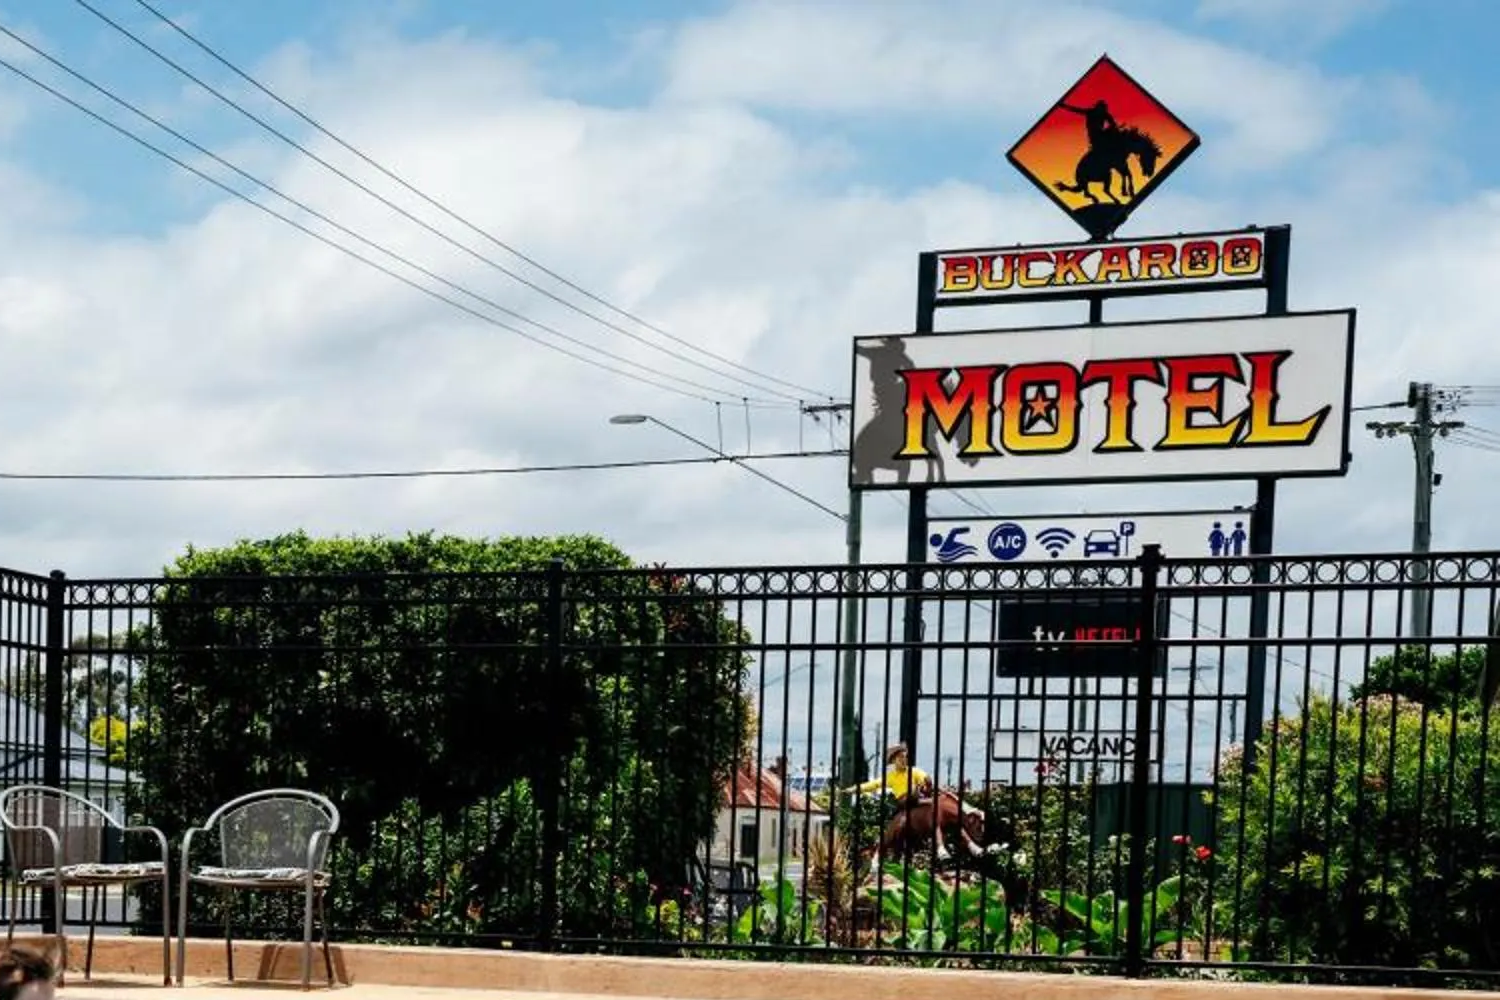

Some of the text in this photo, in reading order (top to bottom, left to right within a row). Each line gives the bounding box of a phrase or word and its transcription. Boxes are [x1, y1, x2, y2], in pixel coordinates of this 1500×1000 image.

[940, 238, 1263, 292] BUCKAROO
[894, 350, 1332, 459] MOTEL
[994, 535, 1022, 549] A/C
[1042, 736, 1138, 755] VACANC
